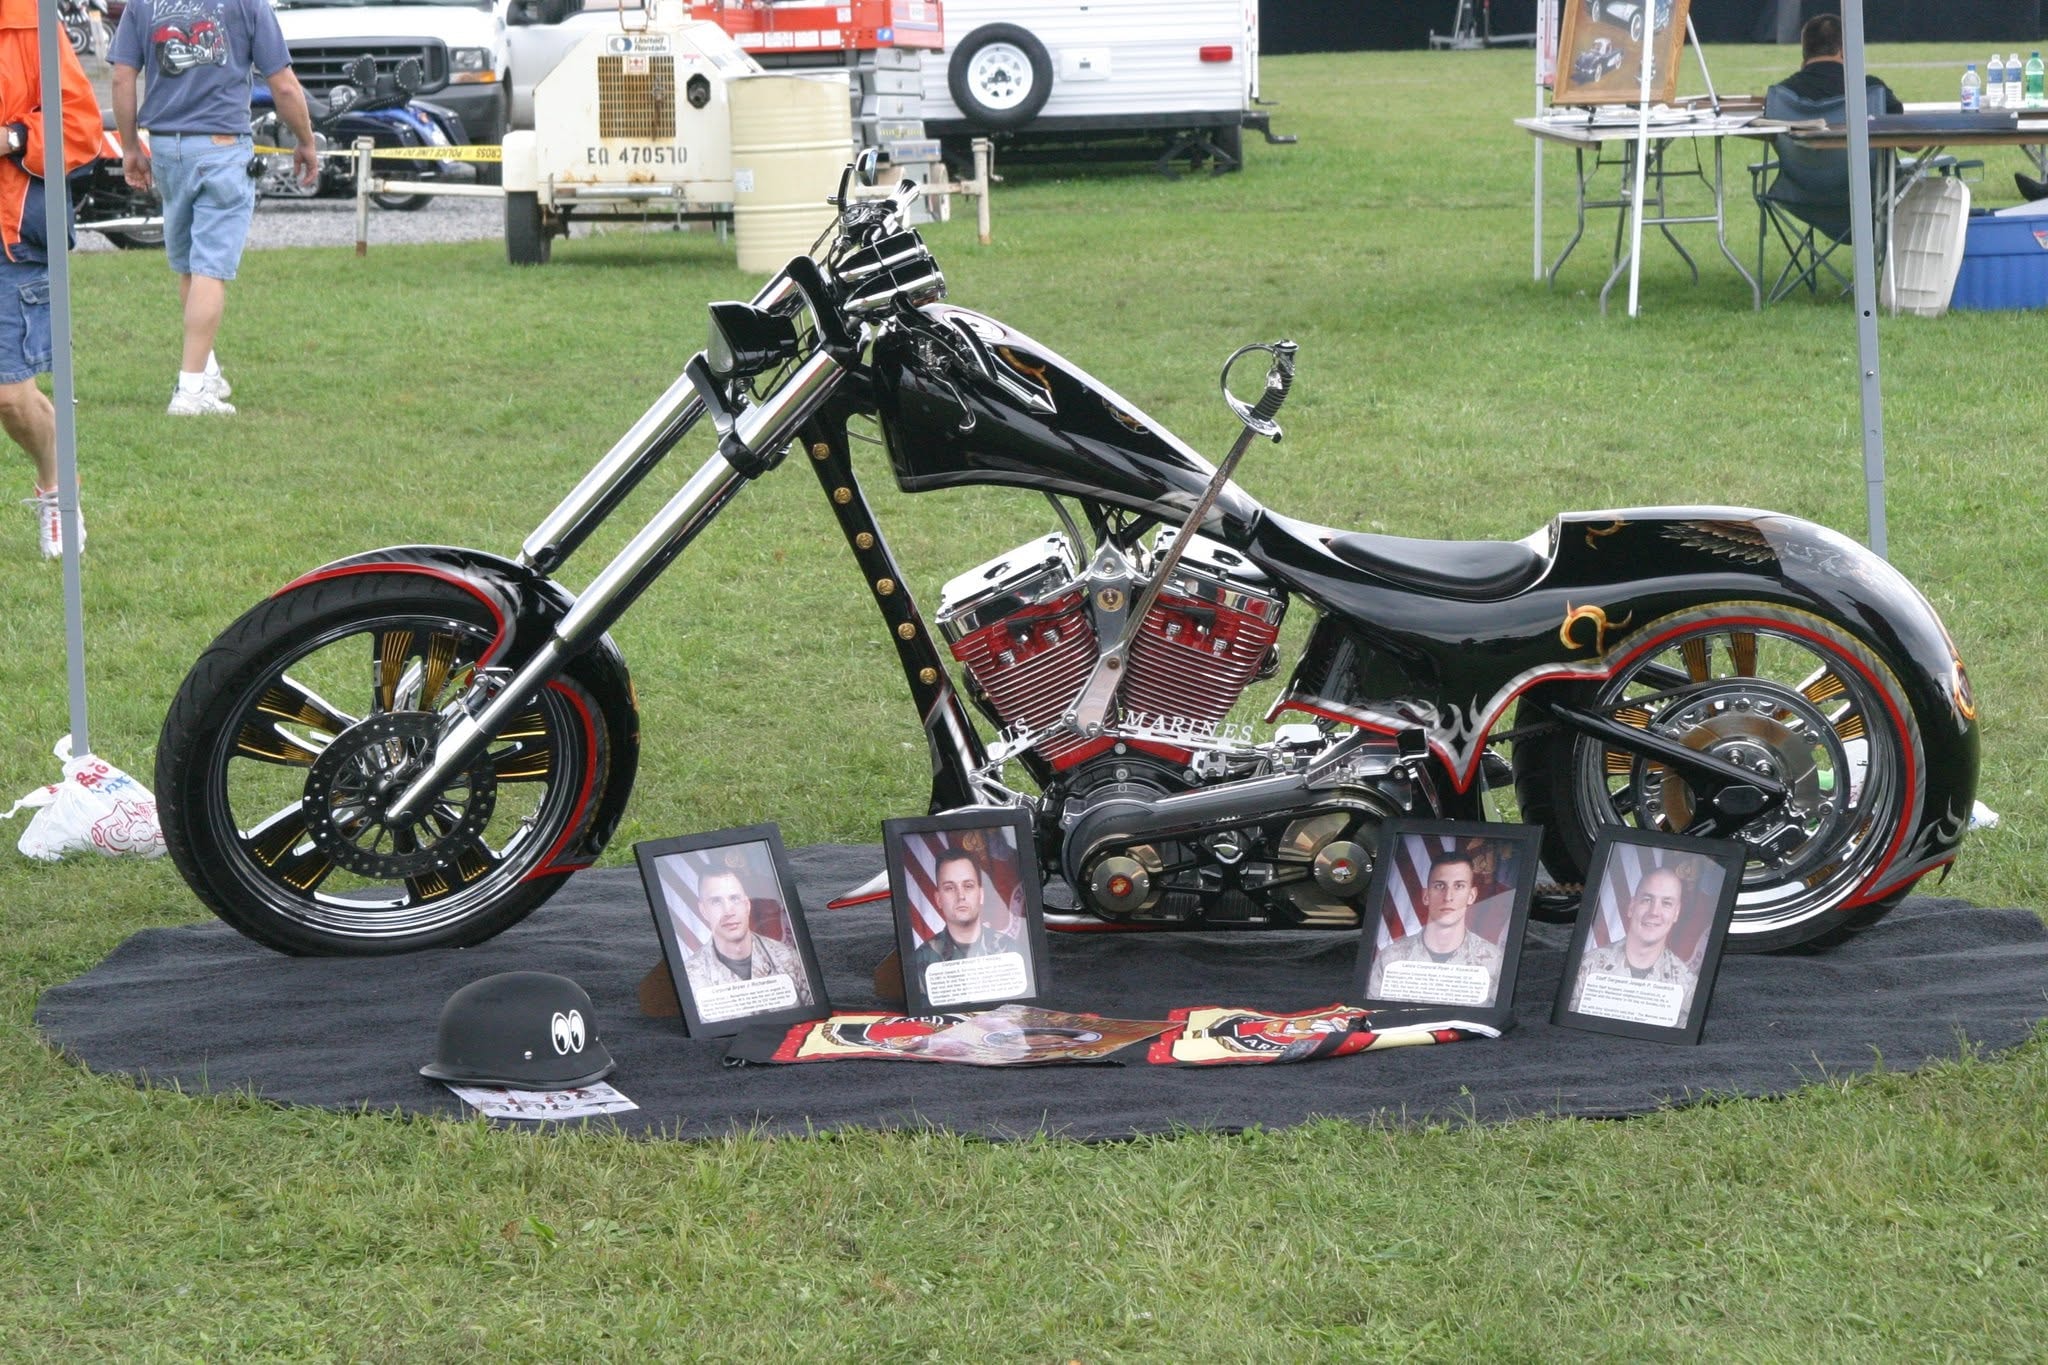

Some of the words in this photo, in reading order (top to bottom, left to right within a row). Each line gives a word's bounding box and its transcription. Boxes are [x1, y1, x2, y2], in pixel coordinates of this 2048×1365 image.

[151, 0, 204, 20] Victory
[634, 36, 665, 45] United
[634, 44, 667, 52] Rentals
[997, 717, 1029, 745] US
[1124, 709, 1253, 741] MARINES
